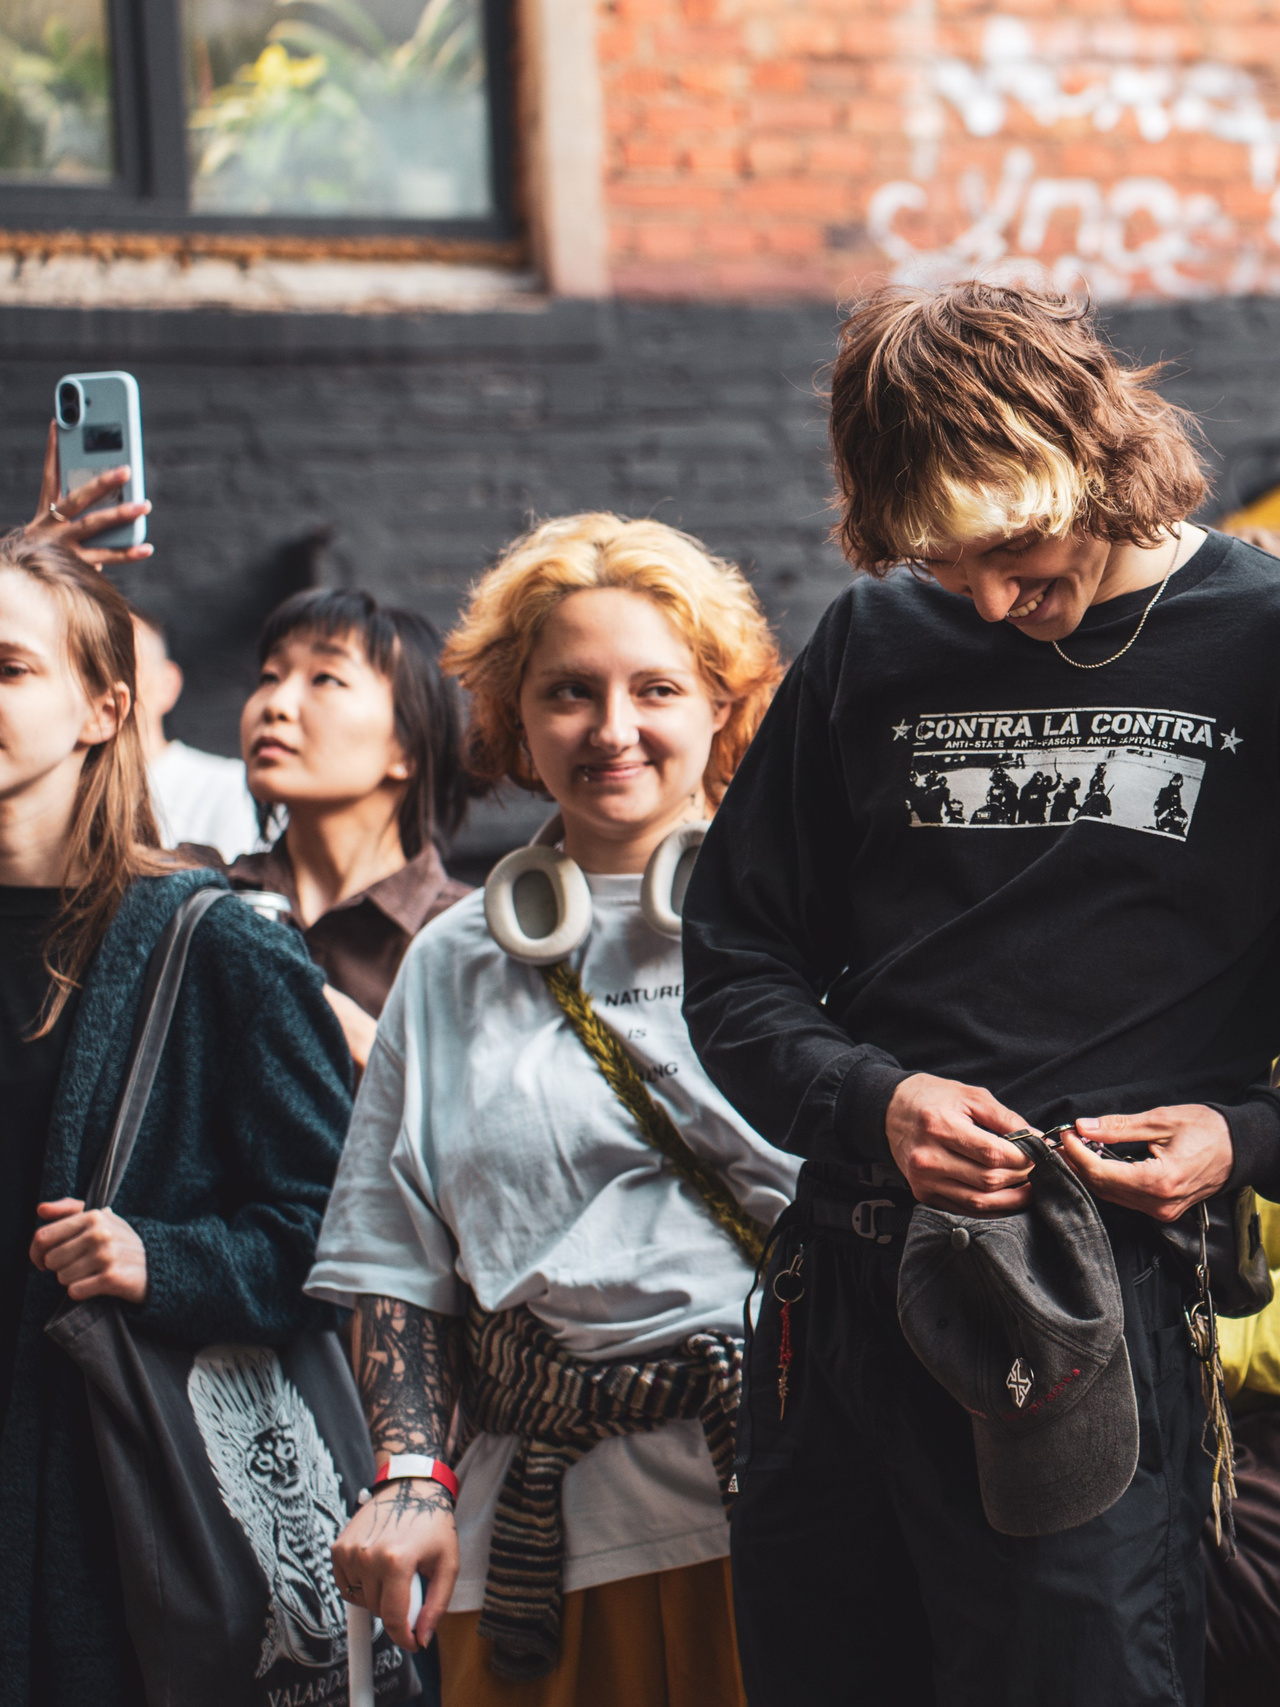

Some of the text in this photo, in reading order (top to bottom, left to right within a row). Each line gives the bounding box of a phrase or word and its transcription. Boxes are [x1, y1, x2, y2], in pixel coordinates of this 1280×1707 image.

[915, 712, 1213, 748] CONTRA LA CONTRA
[604, 984, 684, 1007] NATURE
[626, 1027, 647, 1040] IS
